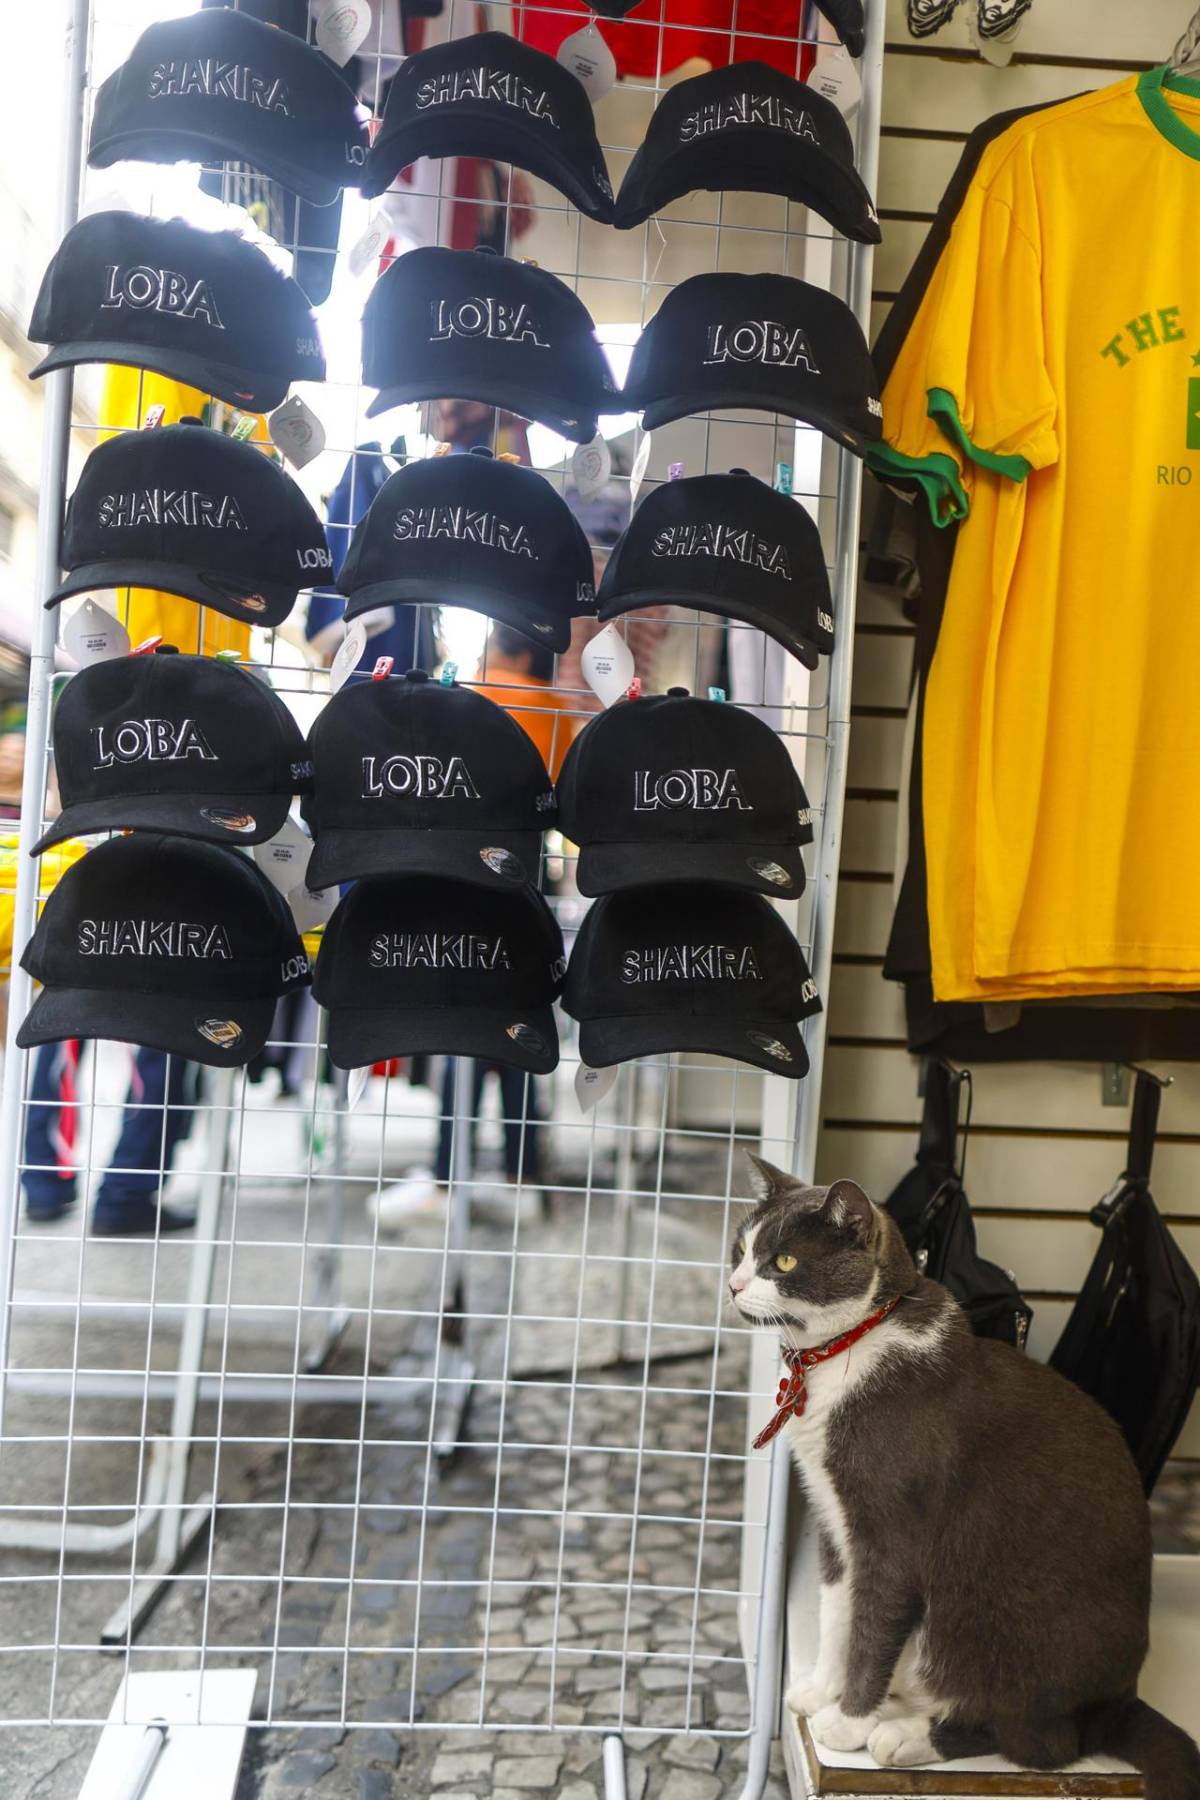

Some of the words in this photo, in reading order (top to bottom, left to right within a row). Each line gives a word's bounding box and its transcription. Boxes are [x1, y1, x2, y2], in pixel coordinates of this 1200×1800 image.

[147, 58, 295, 118] SHAKIRA
[415, 65, 560, 129] SHAKIRA
[679, 92, 821, 146] SHAKIRA
[101, 265, 224, 330] LOBA
[429, 296, 551, 348] LOBA
[703, 320, 822, 375] LOBA
[1100, 306, 1186, 368] THE
[1157, 465, 1192, 486] RIO
[97, 488, 249, 531] SHAKIRA
[392, 505, 539, 561] SHAKIRA
[651, 523, 793, 581] SHAKIRA
[90, 718, 219, 770] LOBA
[361, 754, 482, 800] LOBA
[633, 768, 753, 811] LOBA
[78, 919, 233, 960] SHAKIRA
[369, 933, 514, 971] SHAKIRA
[619, 944, 764, 984] SHAKIRA
